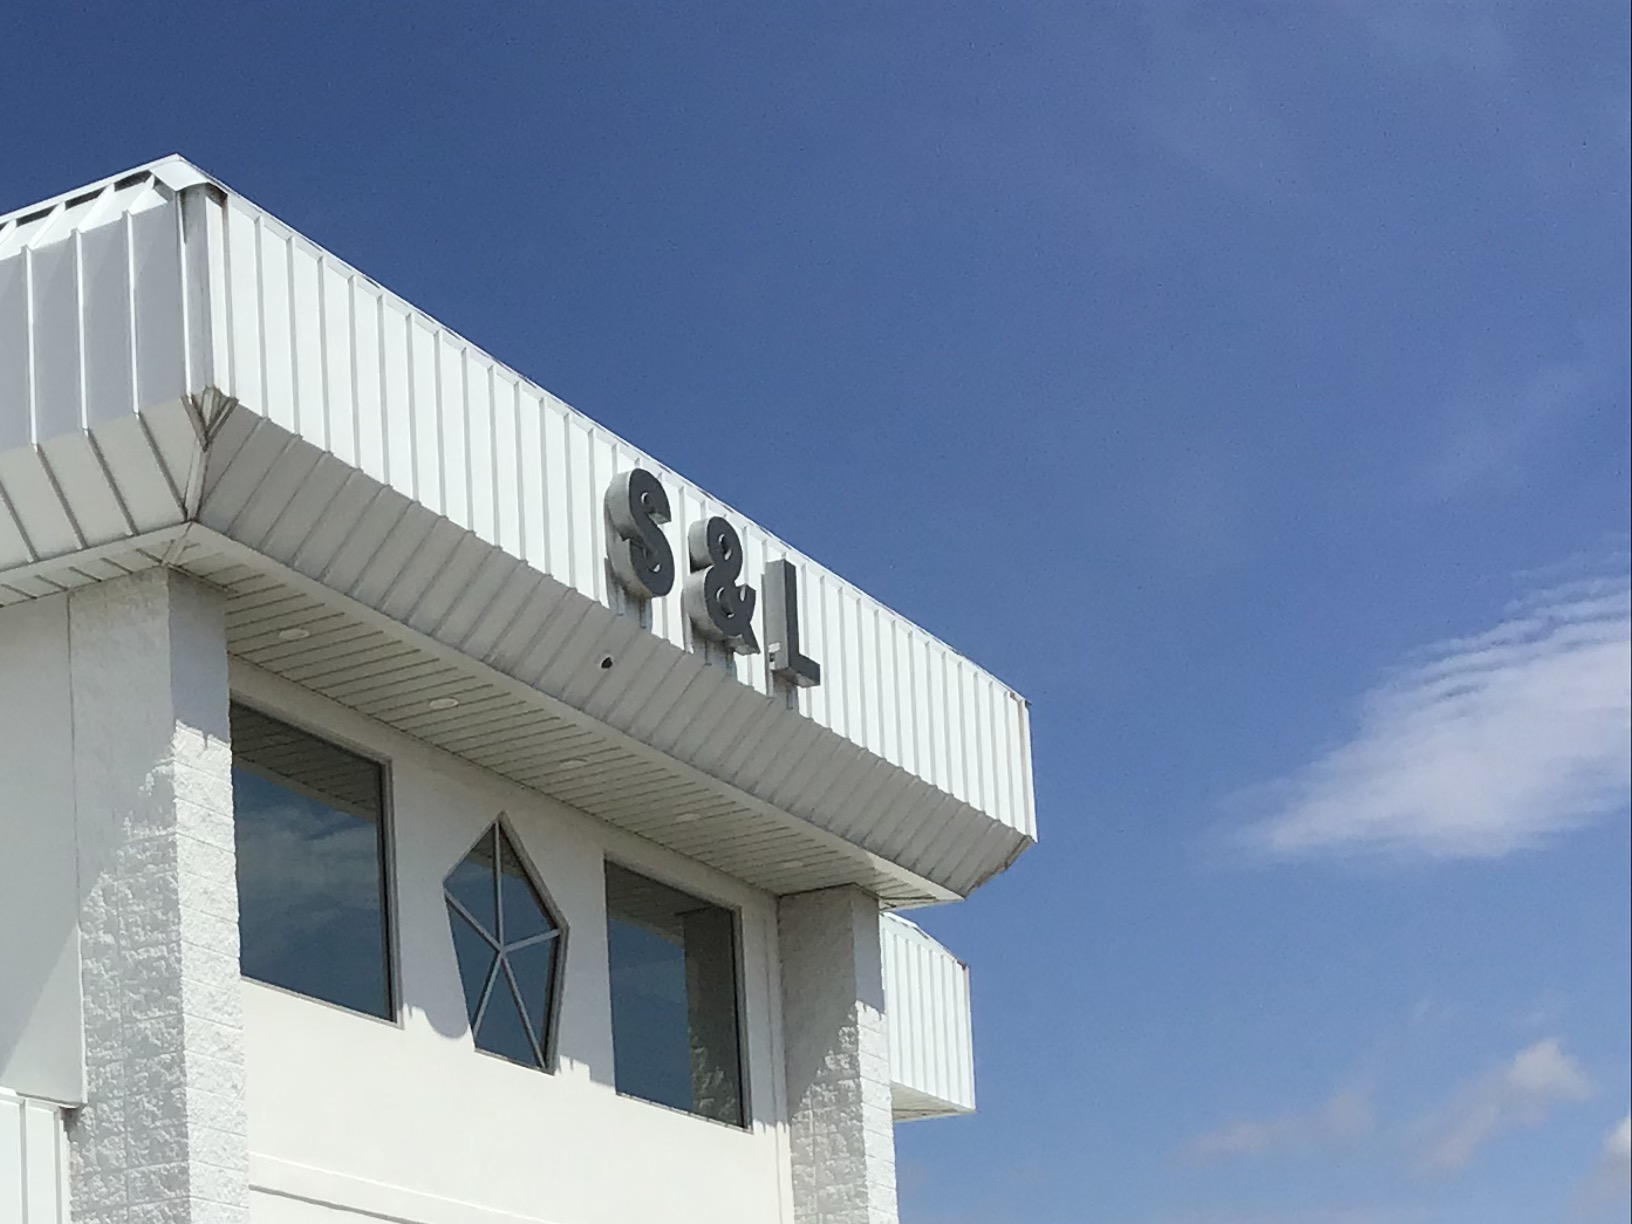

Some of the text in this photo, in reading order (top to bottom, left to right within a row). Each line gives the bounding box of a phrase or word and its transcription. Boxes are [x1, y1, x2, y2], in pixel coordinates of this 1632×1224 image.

[607, 467, 821, 688] S & L
